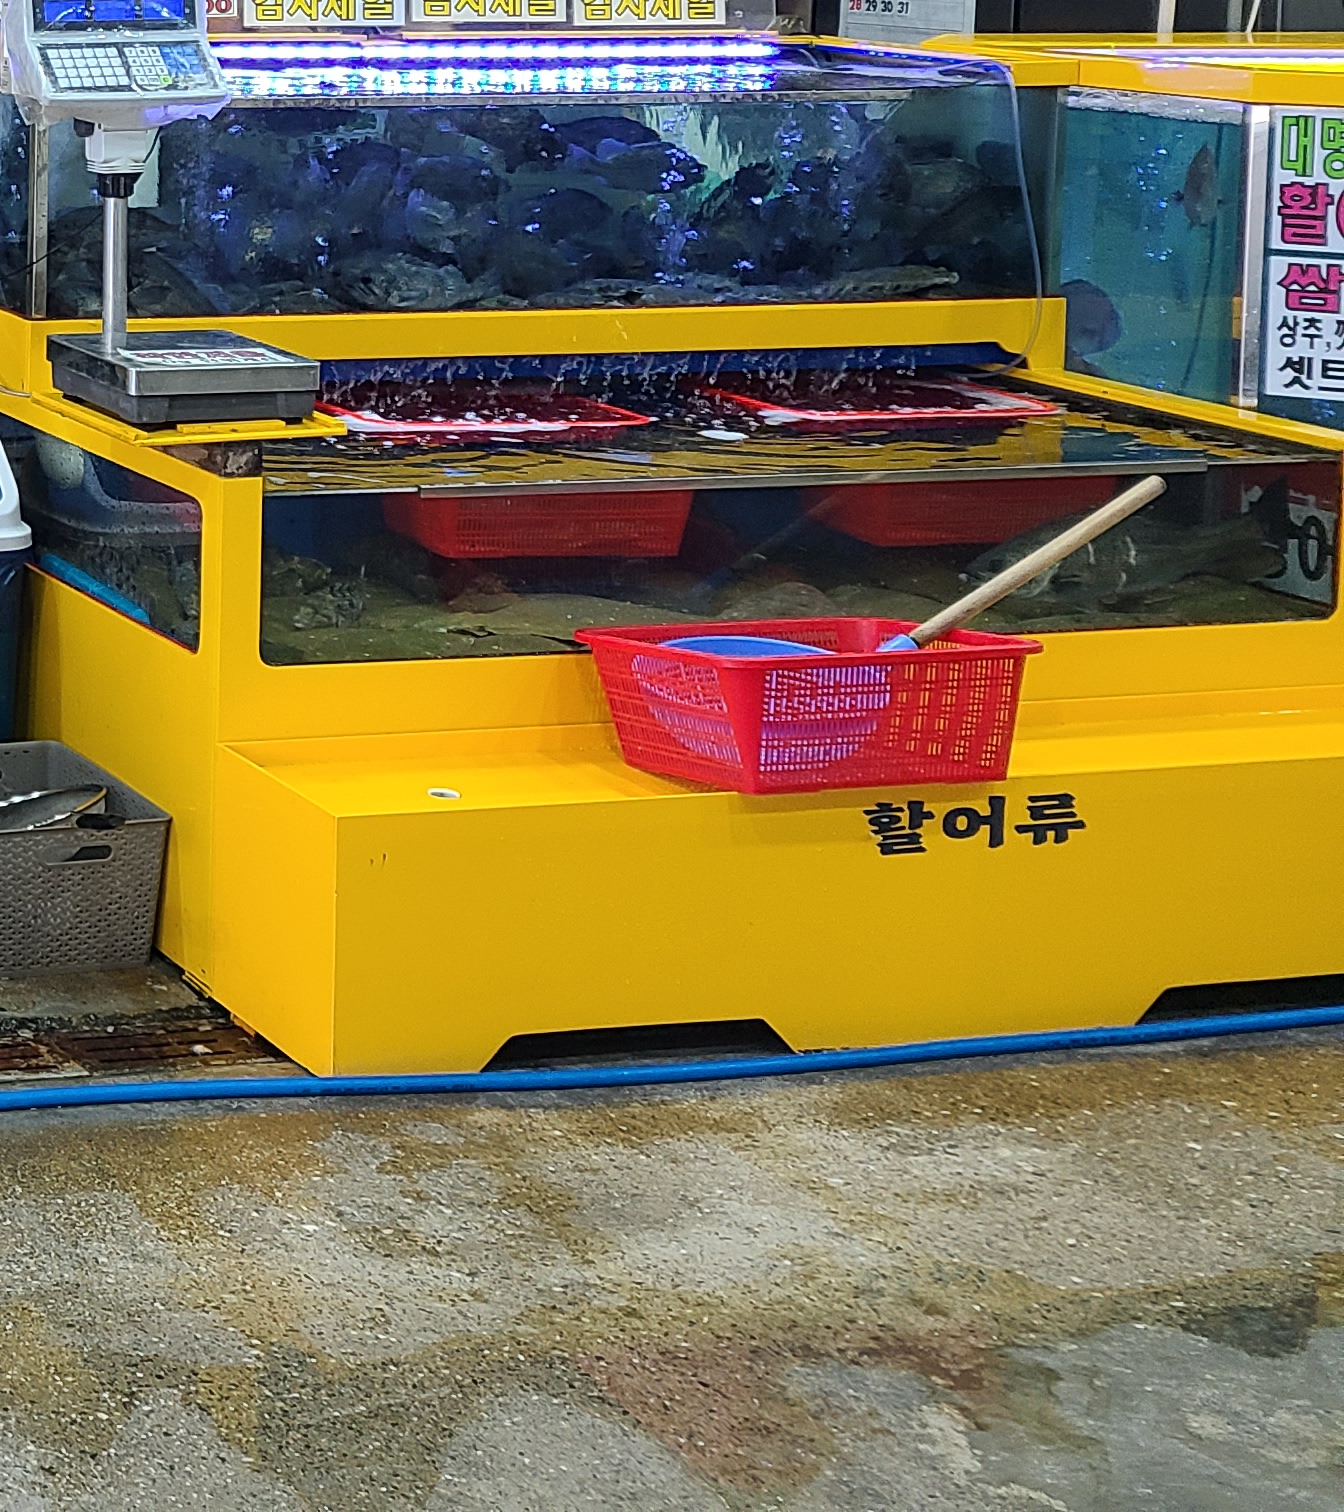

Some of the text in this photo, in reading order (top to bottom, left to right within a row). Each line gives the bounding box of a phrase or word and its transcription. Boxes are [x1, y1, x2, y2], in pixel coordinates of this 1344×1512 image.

[865, 0, 877, 11] 29
[881, 1, 893, 12] 30
[898, 2, 909, 13] 31
[863, 793, 1086, 856] 활어류
